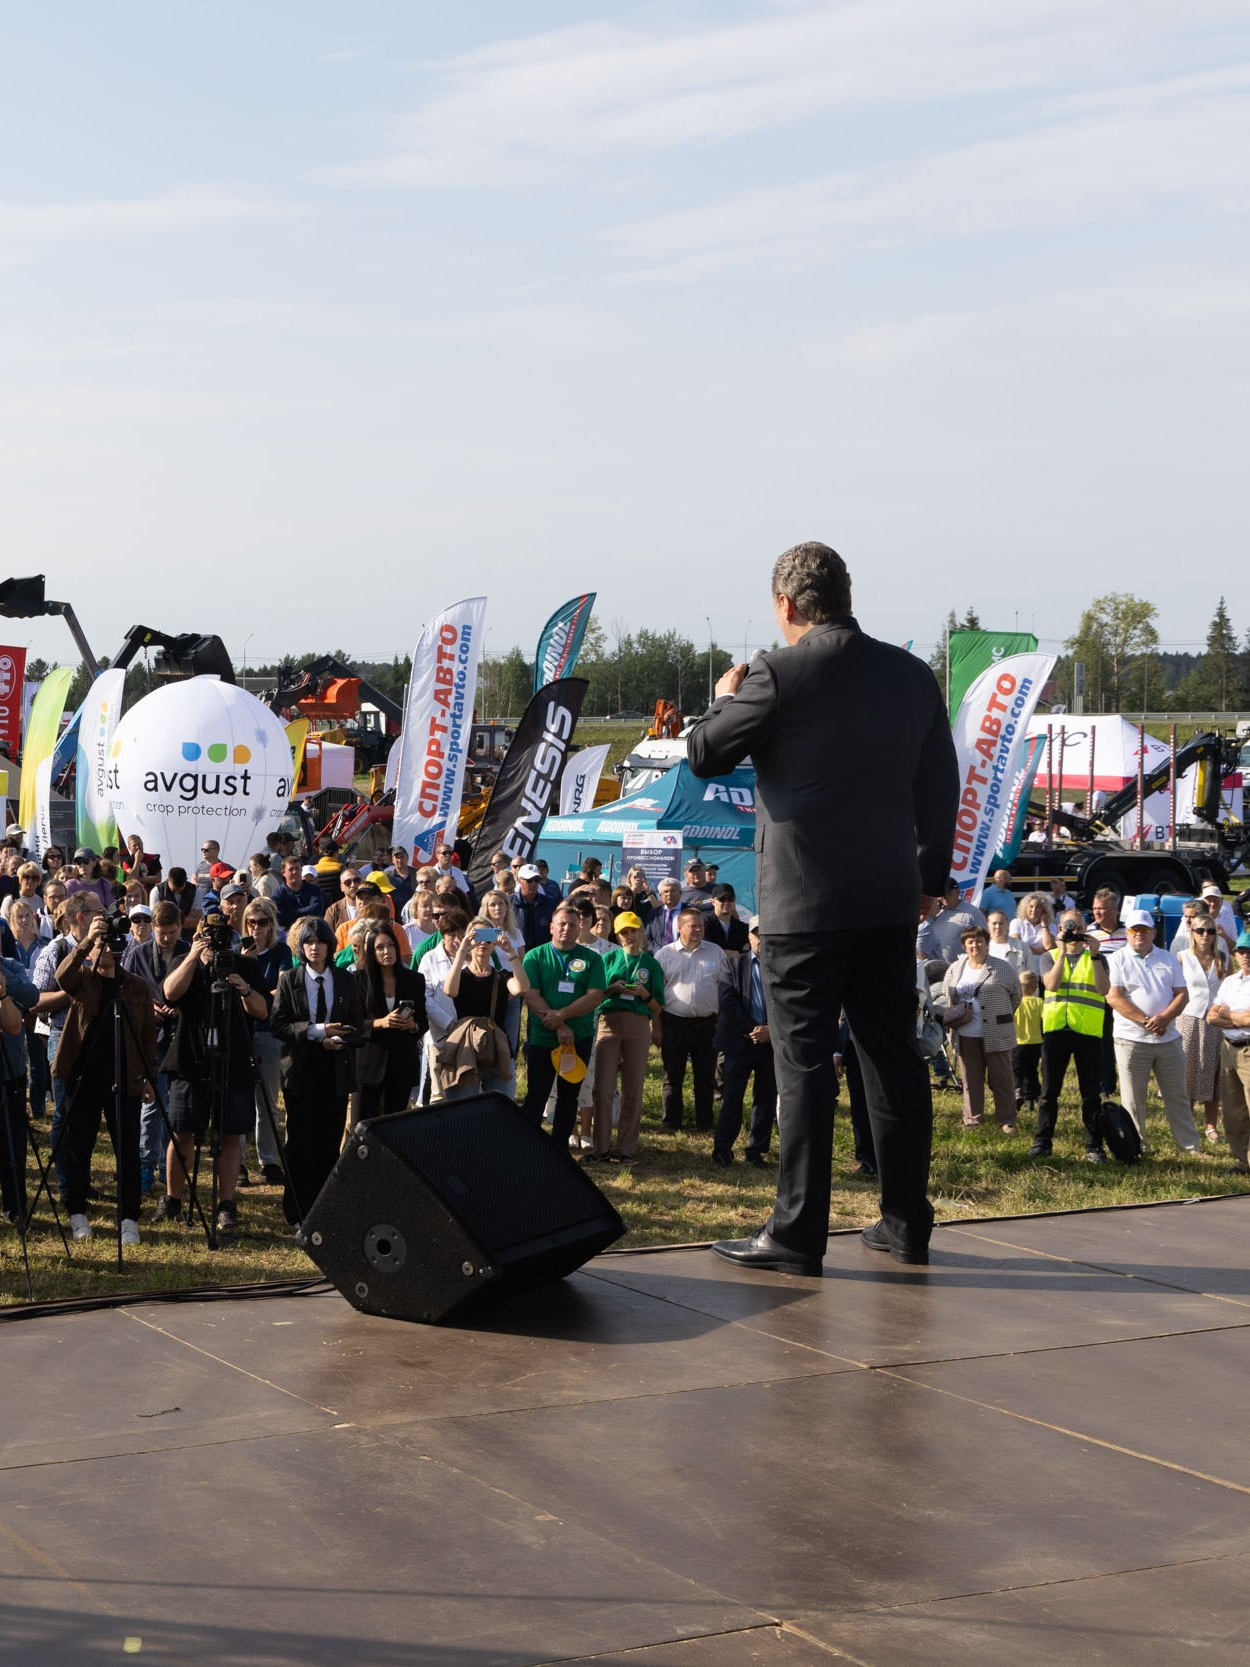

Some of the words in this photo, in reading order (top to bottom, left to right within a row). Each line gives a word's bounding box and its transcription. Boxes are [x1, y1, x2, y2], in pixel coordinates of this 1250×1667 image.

[418, 624, 458, 819] СПОРТ-АВТО
[438, 624, 472, 818] www.sportavto.com
[97, 742, 105, 797] avgust
[144, 769, 251, 801] avgust
[951, 672, 1018, 872] СПОРТ-АВТО
[969, 677, 1033, 875] www.sportavto.com
[146, 802, 174, 816] crop
[178, 805, 247, 817] protection
[544, 819, 585, 833] ADDINOL
[682, 824, 740, 840] ADDINOL
